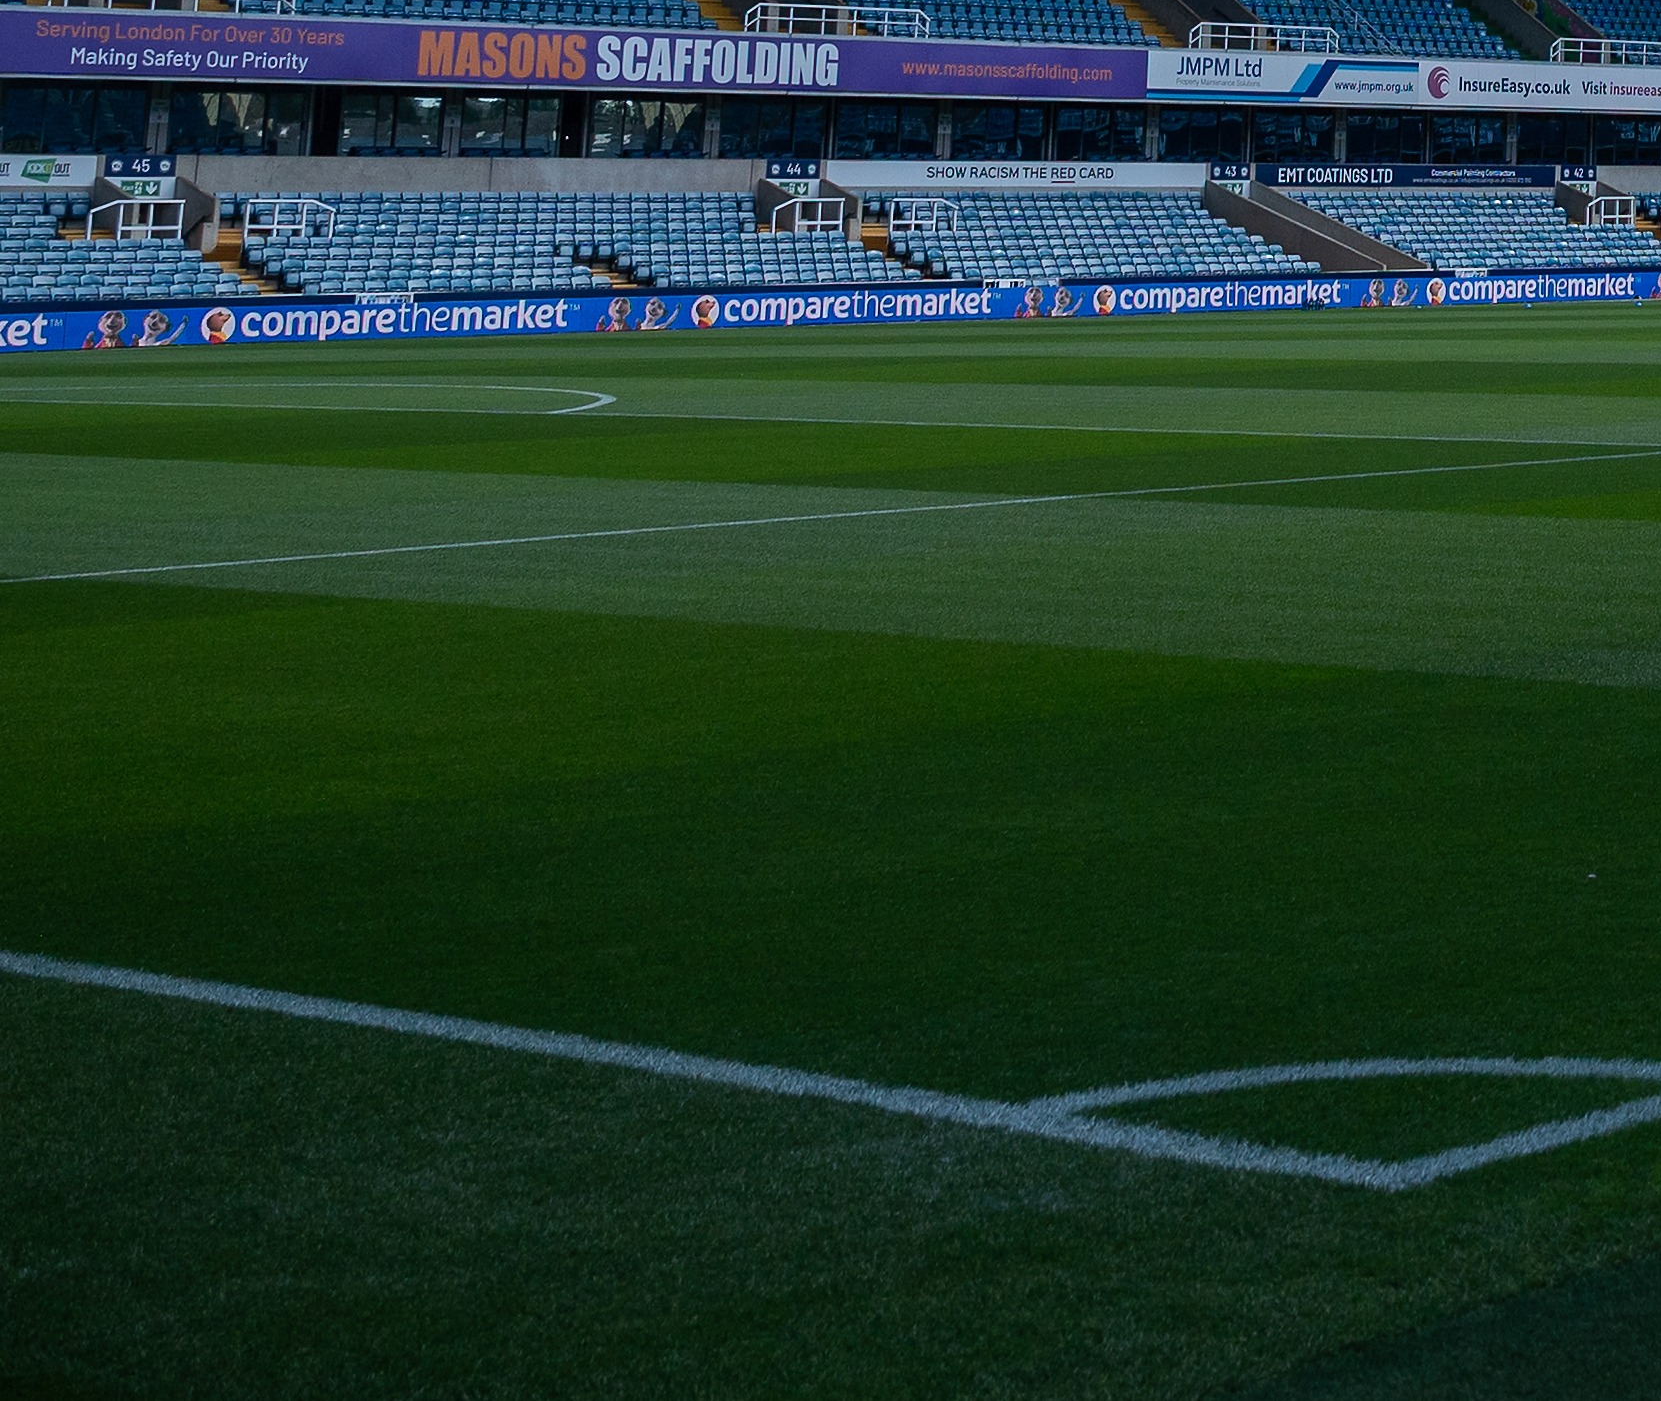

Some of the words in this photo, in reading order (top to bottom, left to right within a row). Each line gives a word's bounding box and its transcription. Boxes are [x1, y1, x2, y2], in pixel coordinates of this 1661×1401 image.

[36, 20, 110, 43] Serving
[115, 23, 185, 41] London
[190, 25, 221, 41] For
[224, 26, 266, 43] Over
[270, 28, 292, 44] 30
[297, 29, 345, 46] Years
[70, 47, 139, 70] Making
[142, 49, 202, 72] Safety
[206, 50, 239, 69] Our
[242, 51, 309, 74] Priority
[417, 30, 586, 80] MASONS
[596, 35, 839, 87] SCAFFOLDING
[1176, 57, 1230, 77] JMPM
[1235, 57, 1262, 78] Ltd
[902, 62, 1113, 83] www.masonsscaffolding.com
[1334, 80, 1414, 94] www.jmpm.org.uk
[1458, 76, 1571, 98] InsureEasy.co.uk
[1581, 81, 1607, 96] Visit
[131, 158, 151, 173] 45
[786, 162, 802, 175] 44
[926, 166, 967, 179] SHOW
[969, 167, 1020, 179] RACISM
[1022, 167, 1047, 179] THE
[1051, 167, 1076, 179] RED
[1079, 167, 1114, 179] CARD
[1225, 165, 1237, 178] 43
[1278, 167, 1305, 183] EMT
[1306, 167, 1369, 184] COATINGS
[1370, 168, 1394, 184] LTD
[1573, 167, 1584, 178] 42
[1119, 280, 1341, 313] comparethemarket
[1448, 272, 1635, 301] comparethemarket
[723, 287, 993, 326] comparethemarket
[241, 296, 568, 341] comparethemarket
